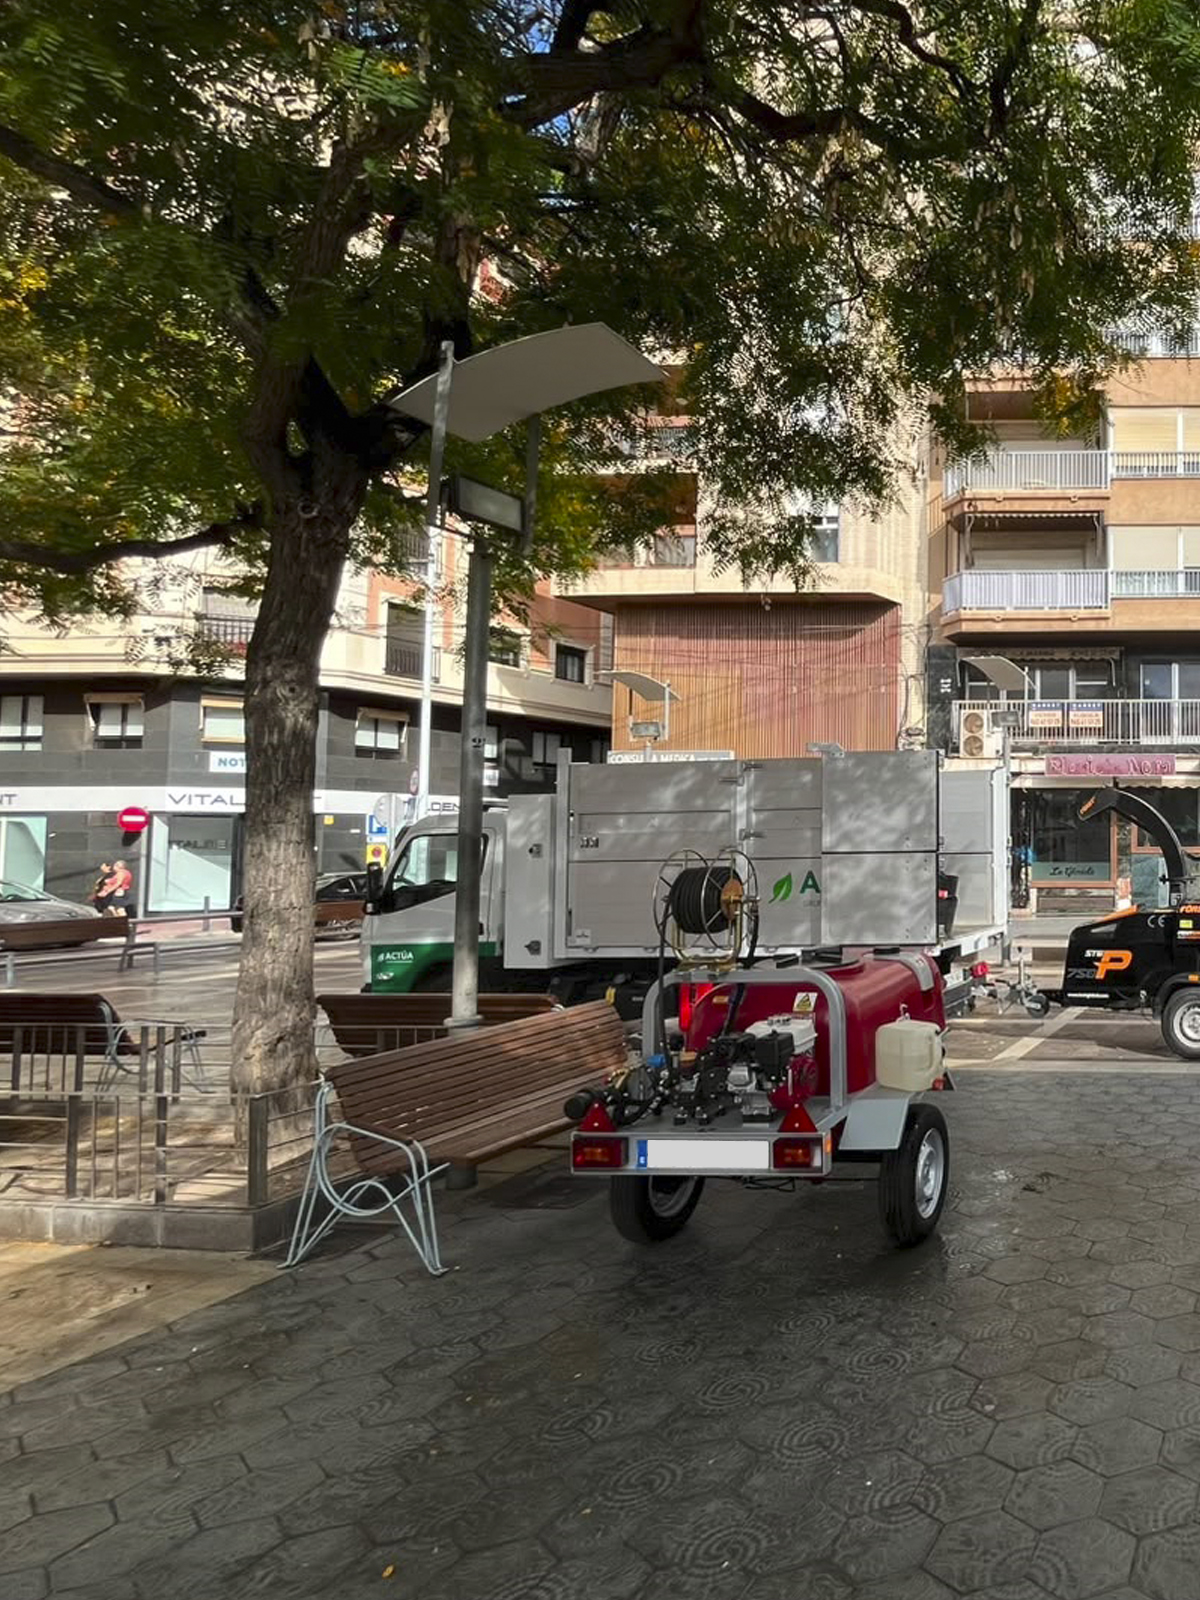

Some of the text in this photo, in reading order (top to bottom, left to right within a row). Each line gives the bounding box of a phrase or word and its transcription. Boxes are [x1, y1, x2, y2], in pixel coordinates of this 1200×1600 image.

[217, 757, 246, 767] NOT
[168, 794, 246, 805] VITAL
[799, 870, 821, 894] A
[385, 949, 414, 960] ACTÚA
